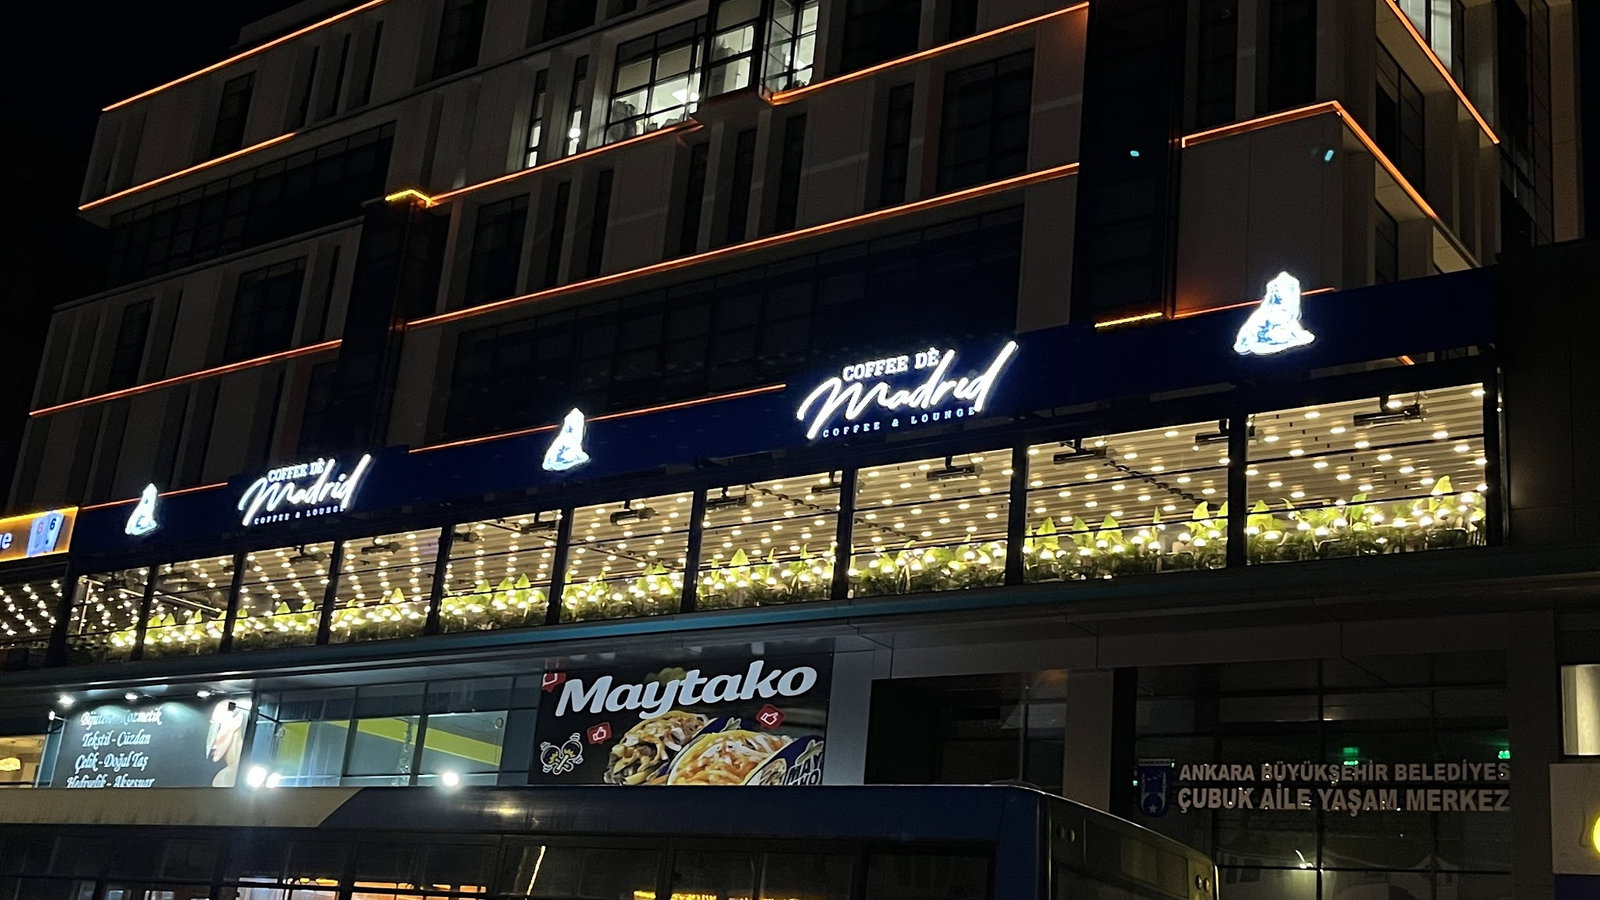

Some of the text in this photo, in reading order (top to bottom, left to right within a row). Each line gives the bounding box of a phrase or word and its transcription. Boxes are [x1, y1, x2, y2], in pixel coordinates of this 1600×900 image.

[842, 355, 909, 382] COFFEE
[796, 340, 1018, 440] Madrid
[822, 406, 976, 438] COFFEE & LOUNGE
[268, 464, 308, 482] COFFEE
[238, 453, 372, 527] Madrid
[253, 513, 290, 525] COFFEE
[555, 660, 818, 720] Maytako
[82, 730, 114, 750] Tekstil
[117, 728, 151, 747] Cüzdan
[104, 751, 134, 772] Doğal
[133, 752, 149, 771] Taş
[1179, 764, 1255, 781] ANKARA
[1261, 760, 1388, 786] BÜYÜKŞEHİR
[1178, 783, 1511, 817] ÇUBUK AİLE YAŞAM MERKEZ
